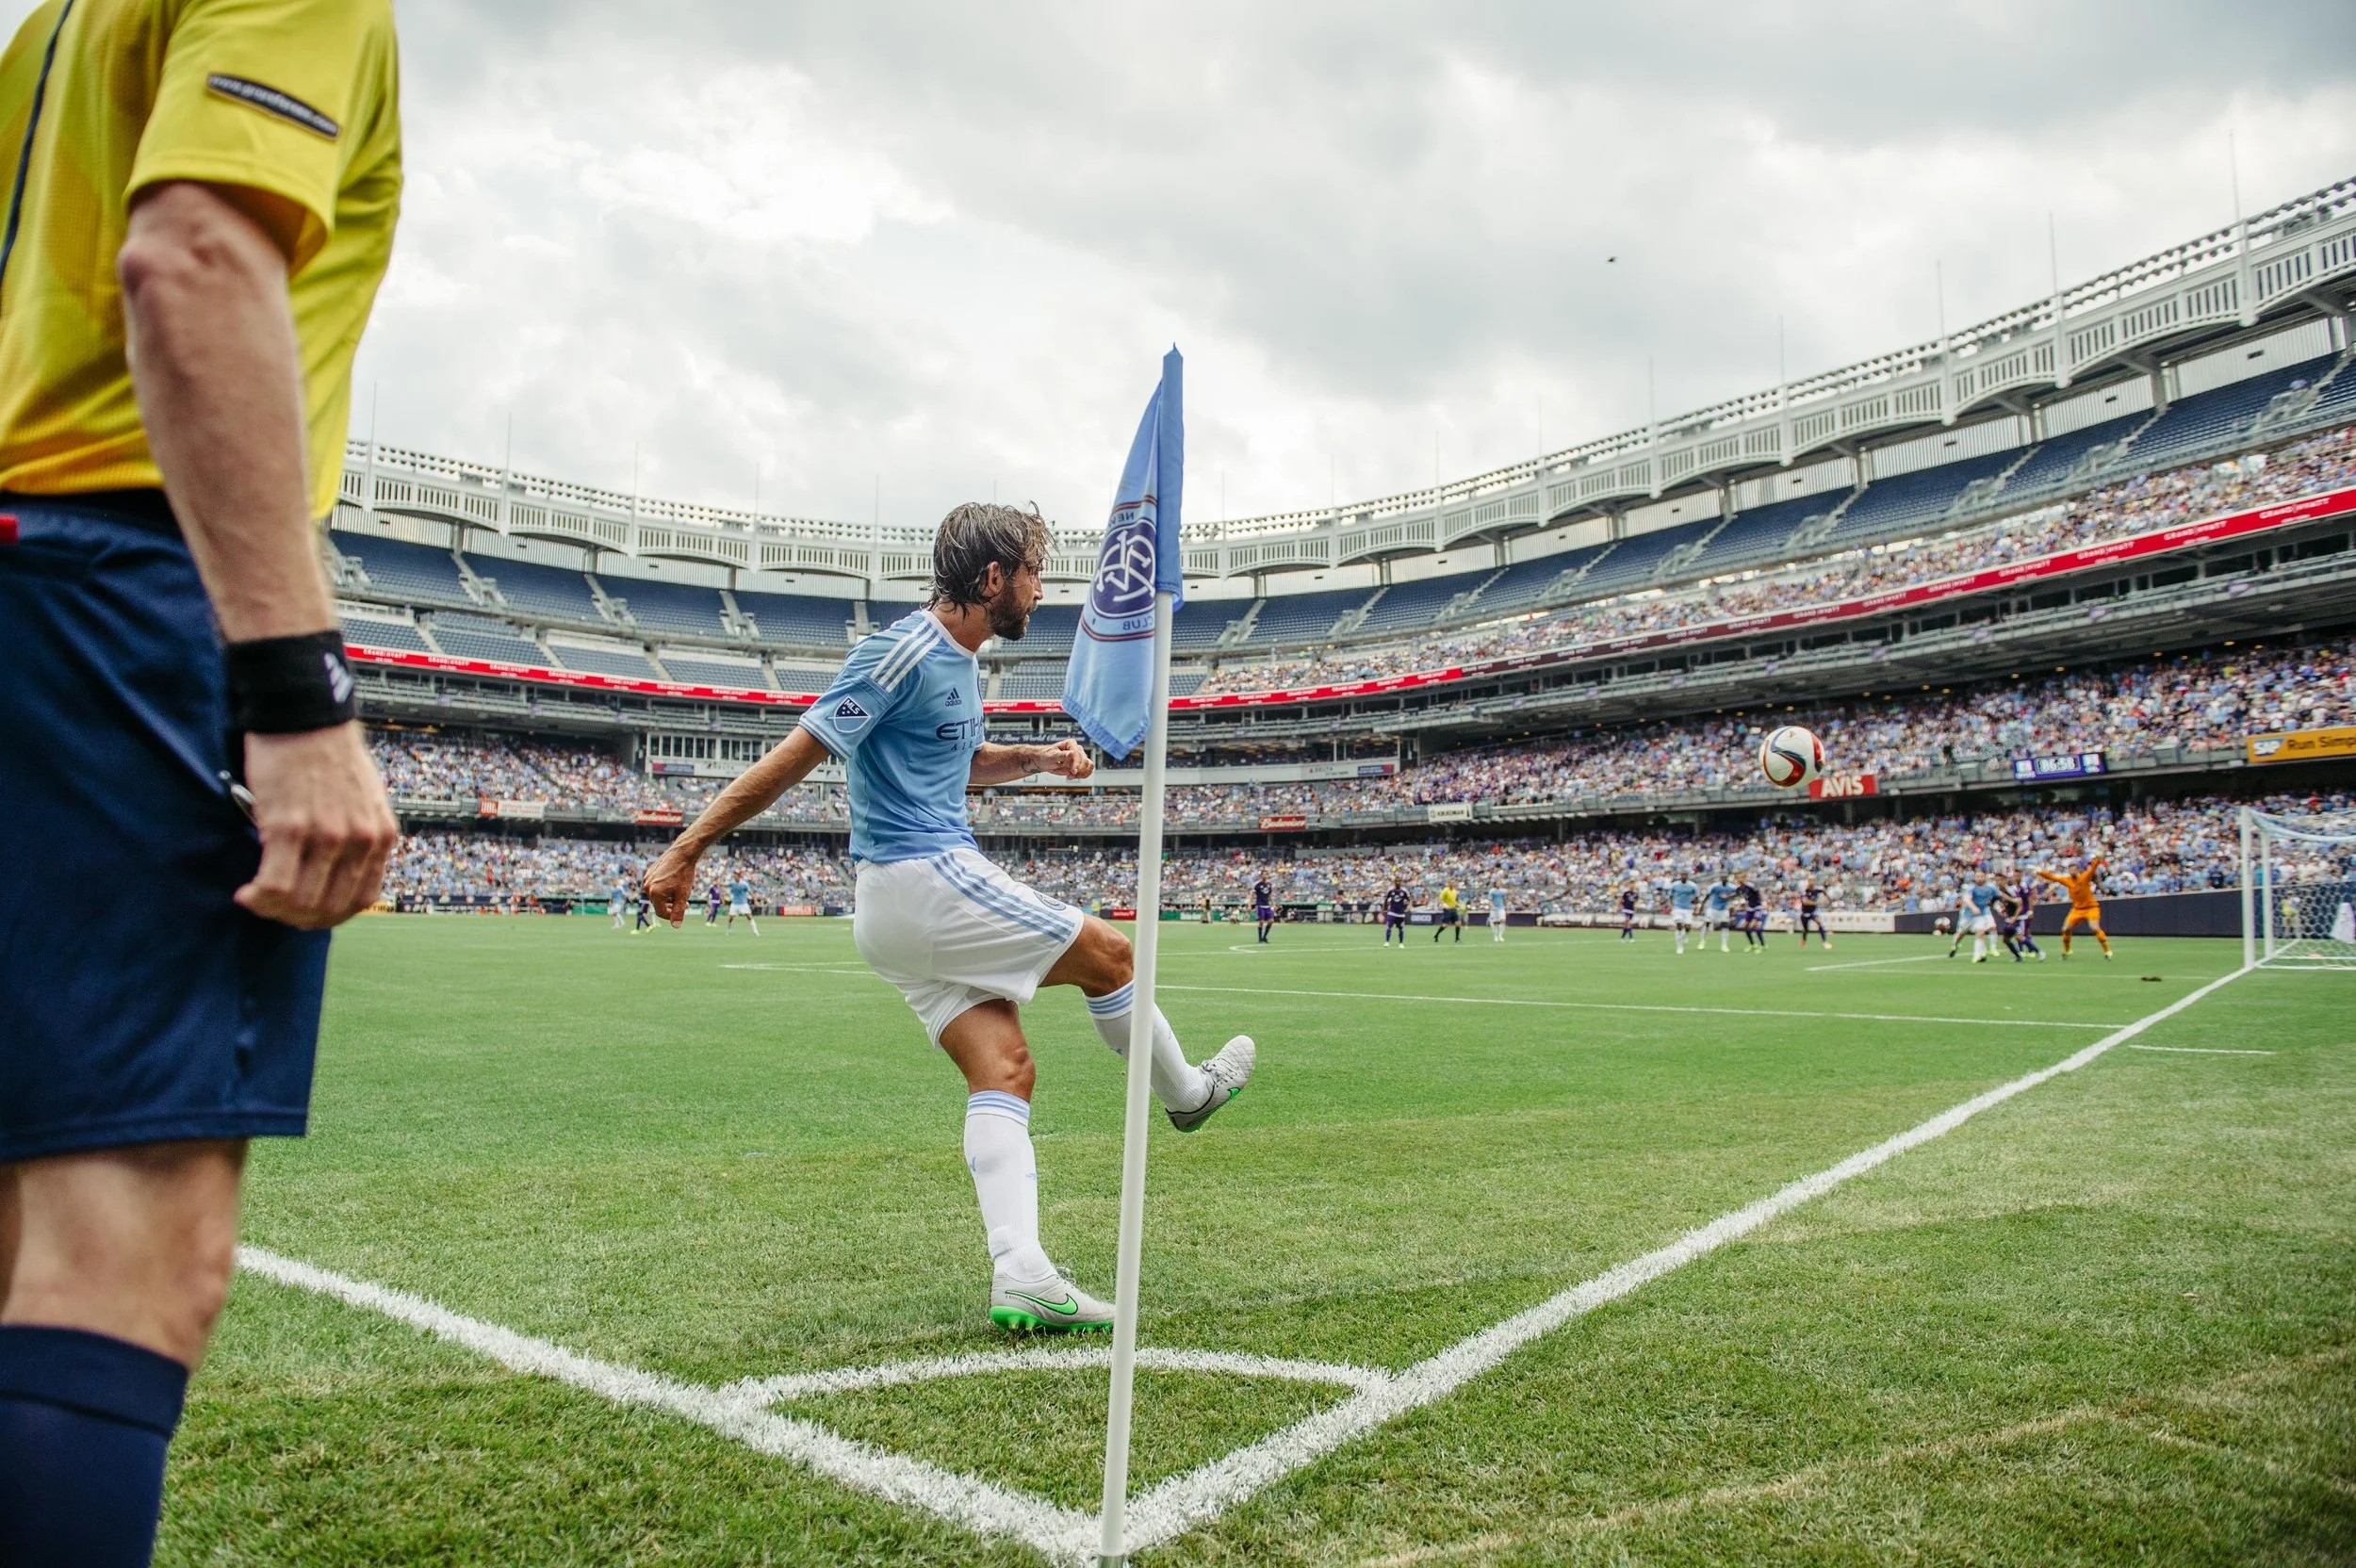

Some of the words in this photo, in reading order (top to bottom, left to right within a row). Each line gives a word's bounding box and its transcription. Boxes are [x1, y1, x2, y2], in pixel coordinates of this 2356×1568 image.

[843, 699, 860, 714] MLS
[2254, 741, 2280, 755] SAP
[2287, 739, 2315, 750] Run
[1821, 775, 1864, 798] AVIS
